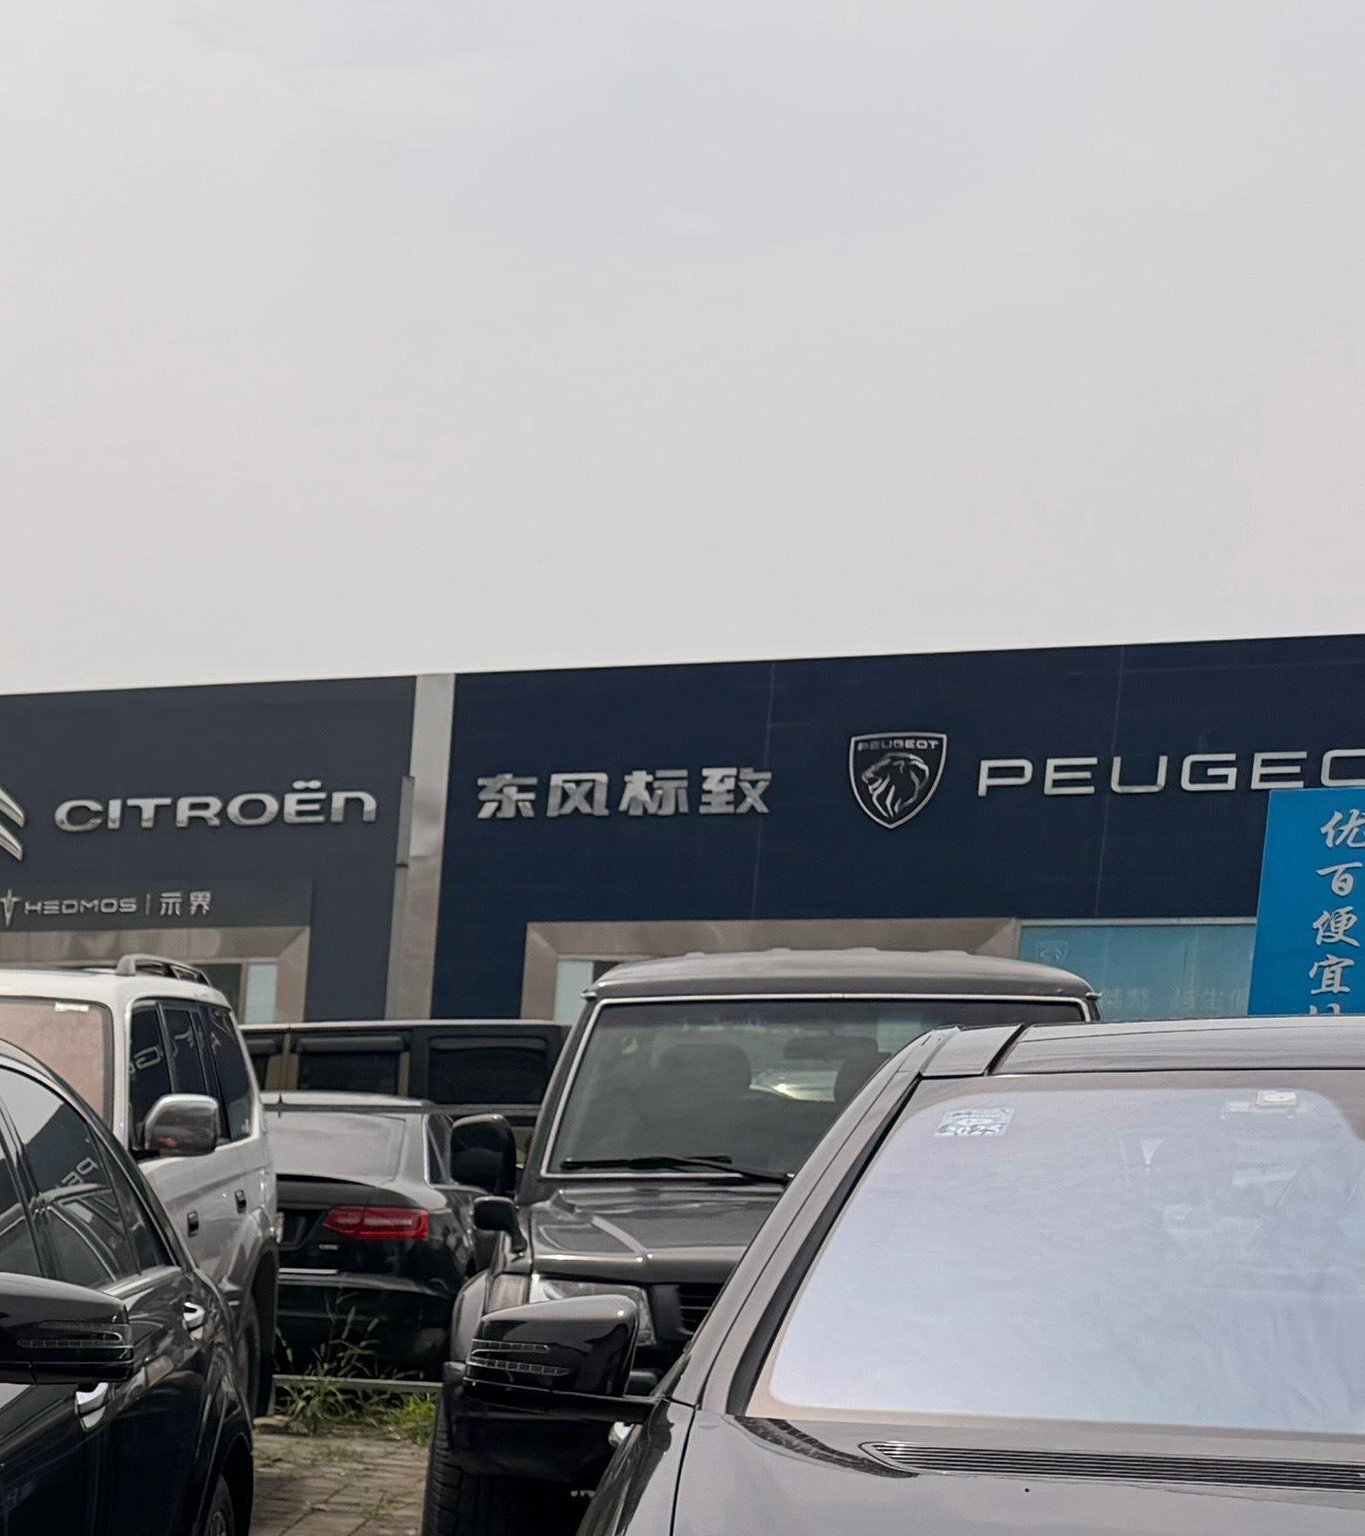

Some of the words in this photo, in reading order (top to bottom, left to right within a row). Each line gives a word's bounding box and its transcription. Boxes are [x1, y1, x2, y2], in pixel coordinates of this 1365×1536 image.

[857, 738, 939, 751] PEUGEOT
[476, 766, 773, 820] 东风标致
[159, 891, 212, 917] 示界
[1308, 808, 1365, 1016] 优百便宜
